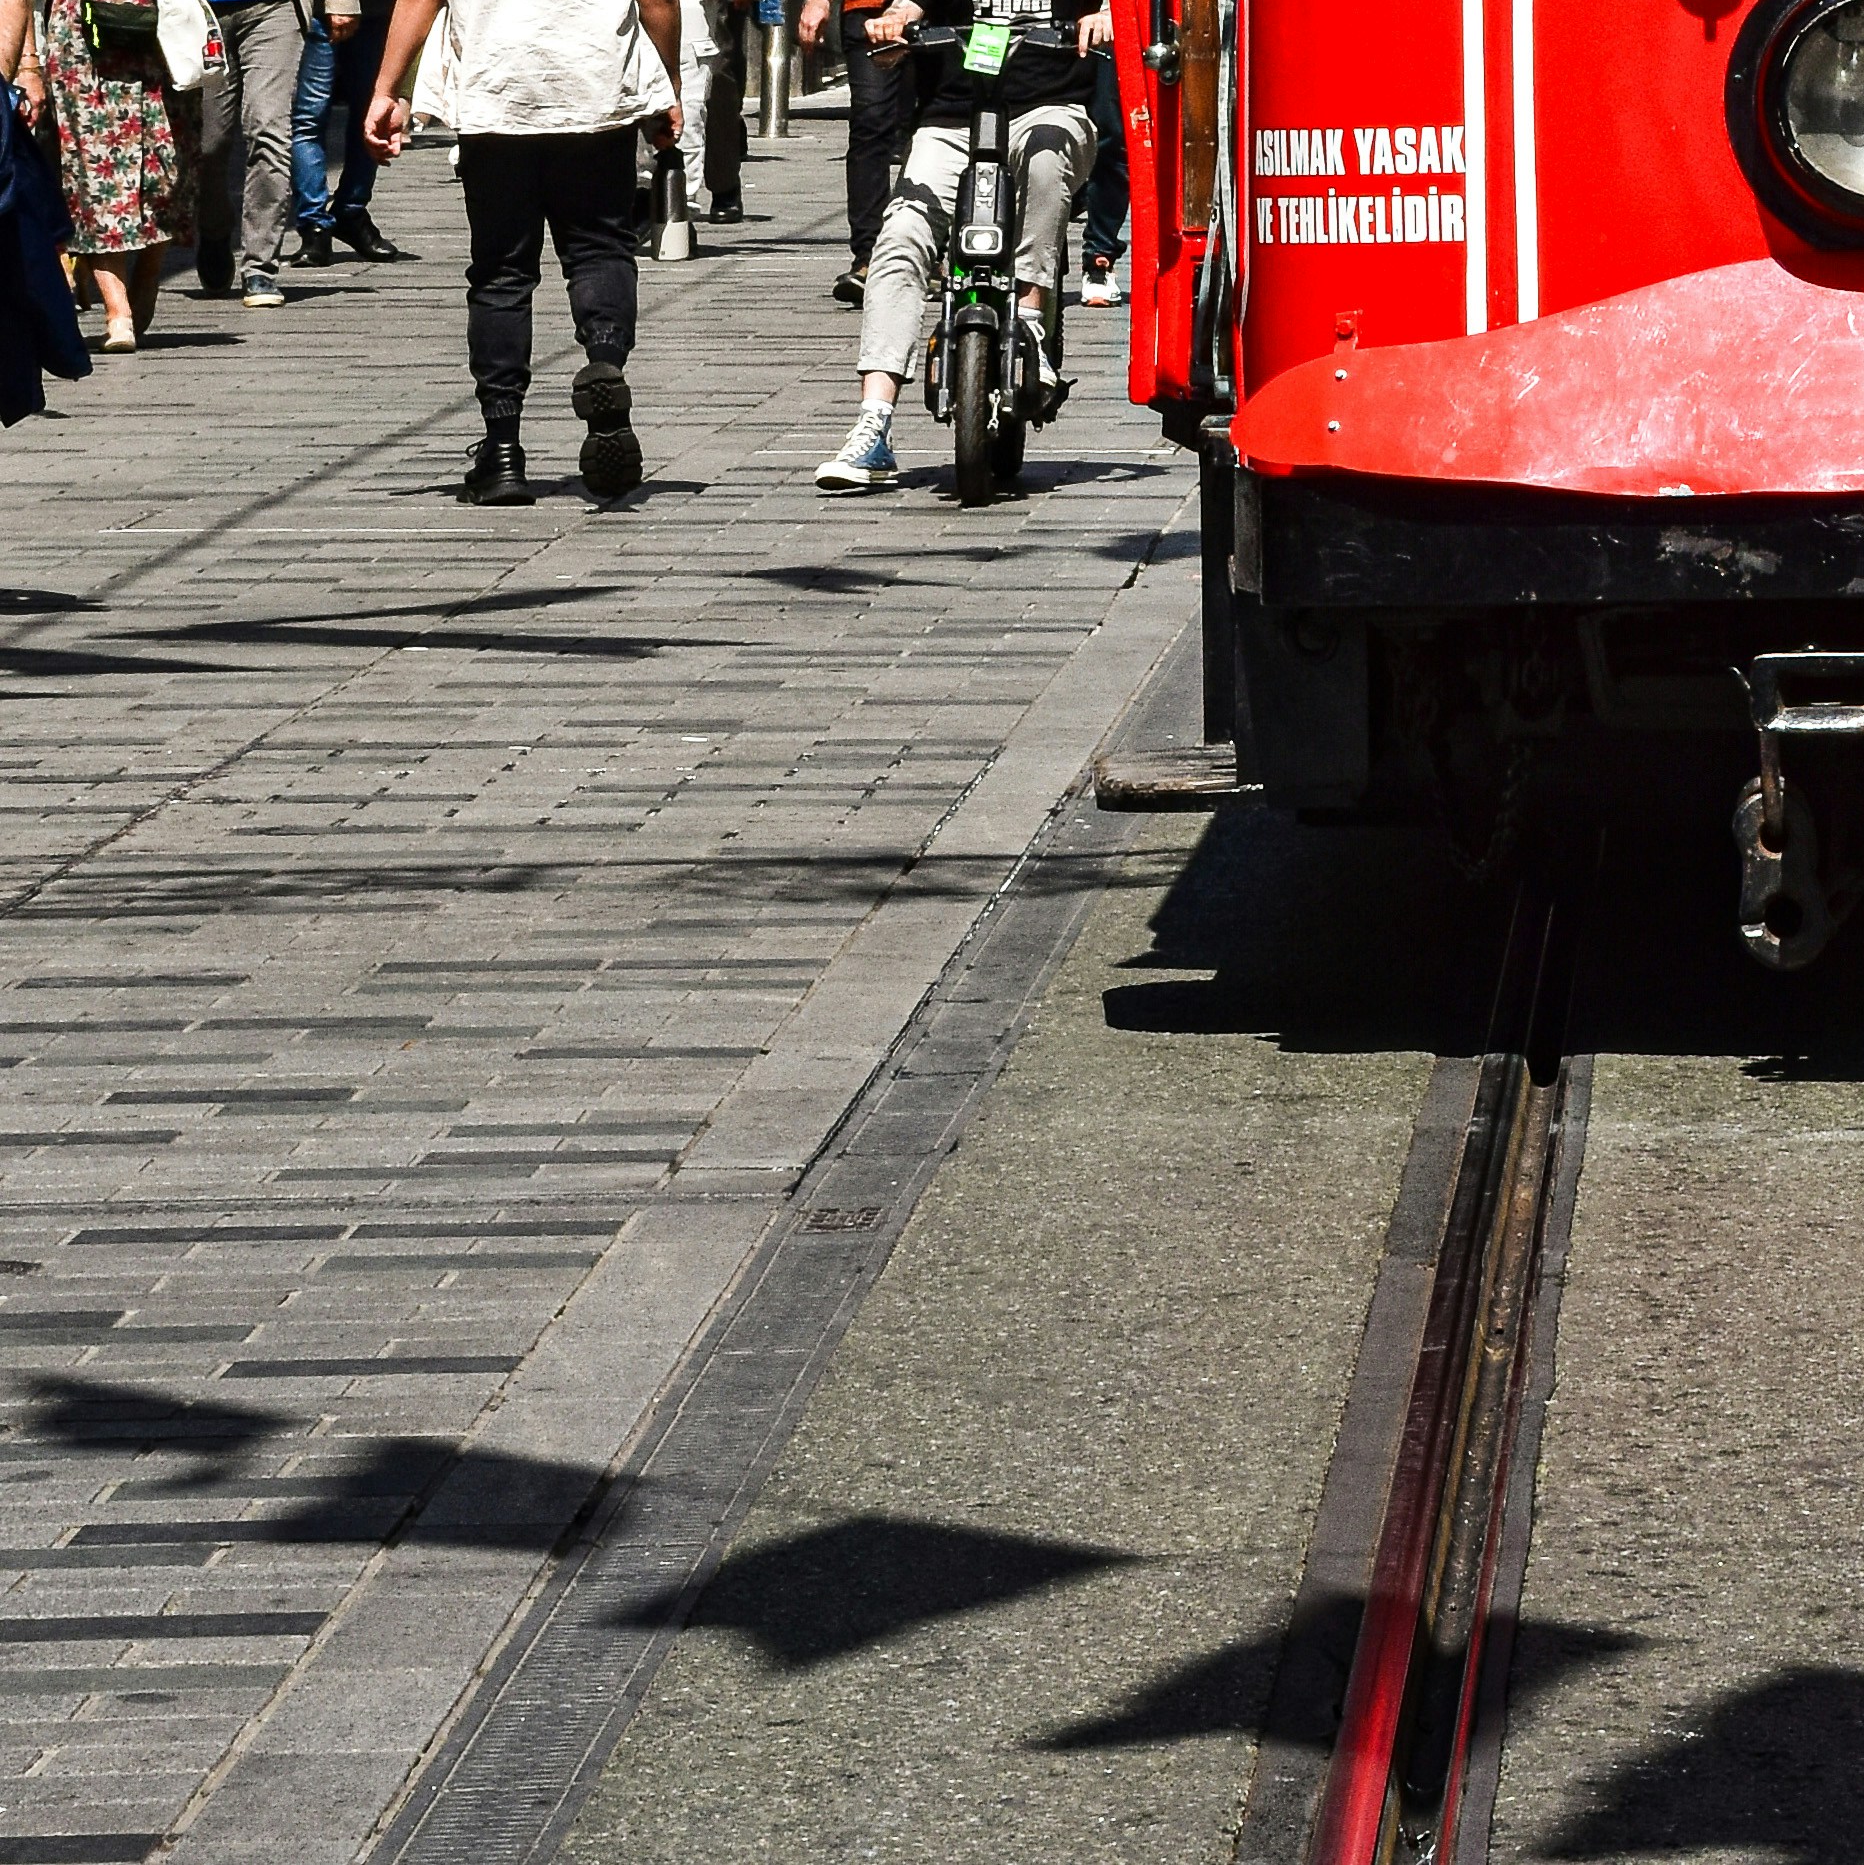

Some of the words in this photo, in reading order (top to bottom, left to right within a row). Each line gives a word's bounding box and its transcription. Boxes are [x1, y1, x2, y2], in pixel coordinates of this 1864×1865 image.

[1255, 128, 1346, 176] ASILMAK
[1353, 125, 1466, 175] YASAK
[1256, 196, 1274, 244] VE
[1277, 185, 1465, 244] TEHLİKELİDİR
